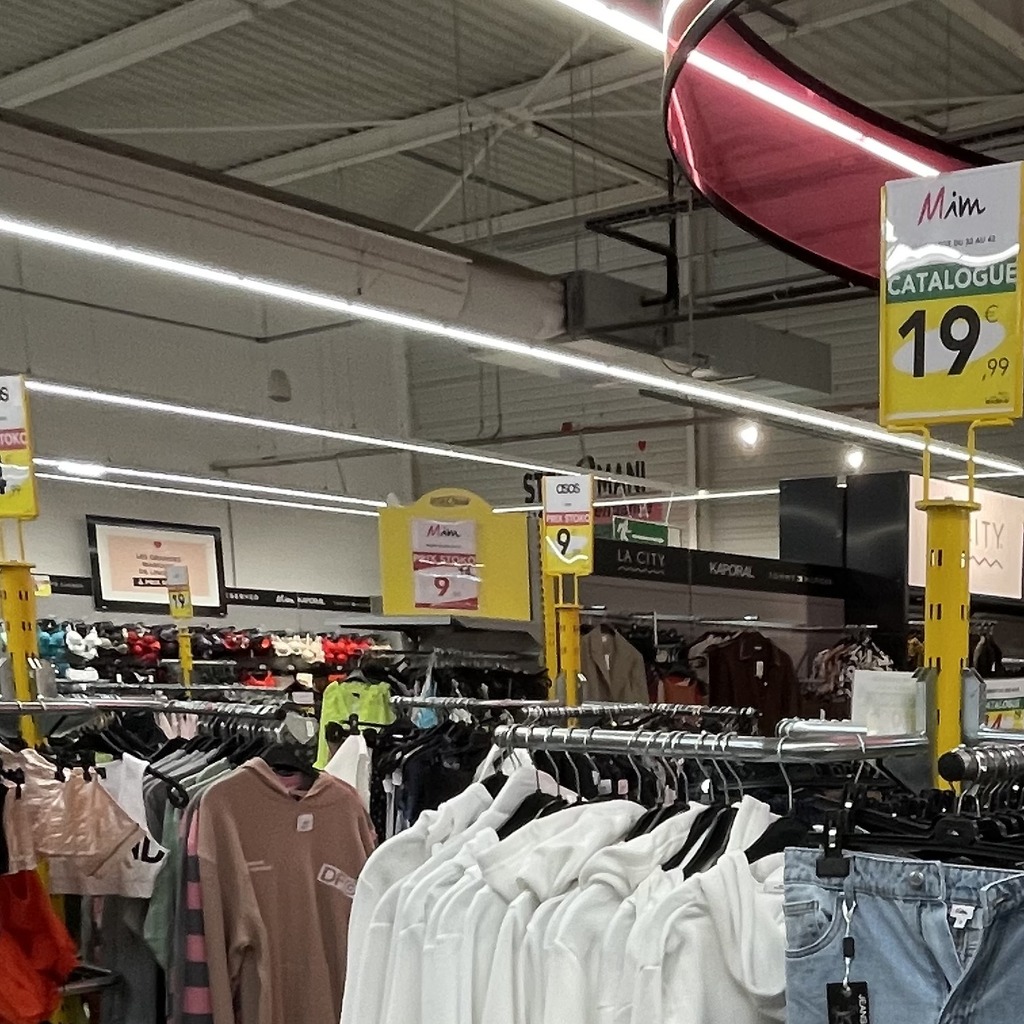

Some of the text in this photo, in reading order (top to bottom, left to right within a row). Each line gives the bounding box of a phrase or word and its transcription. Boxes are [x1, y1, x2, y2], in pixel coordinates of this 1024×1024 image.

[917, 186, 986, 225] Mim
[888, 262, 1017, 296] CATALOGUE
[899, 304, 981, 378] 19
[556, 483, 581, 495] asos
[557, 528, 571, 556] 9
[972, 518, 1005, 549] ITY
[617, 549, 665, 567] LA CITY
[709, 561, 756, 579] KAPORAL
[434, 576, 450, 597] 9
[857, 994, 868, 1024] JEANS
